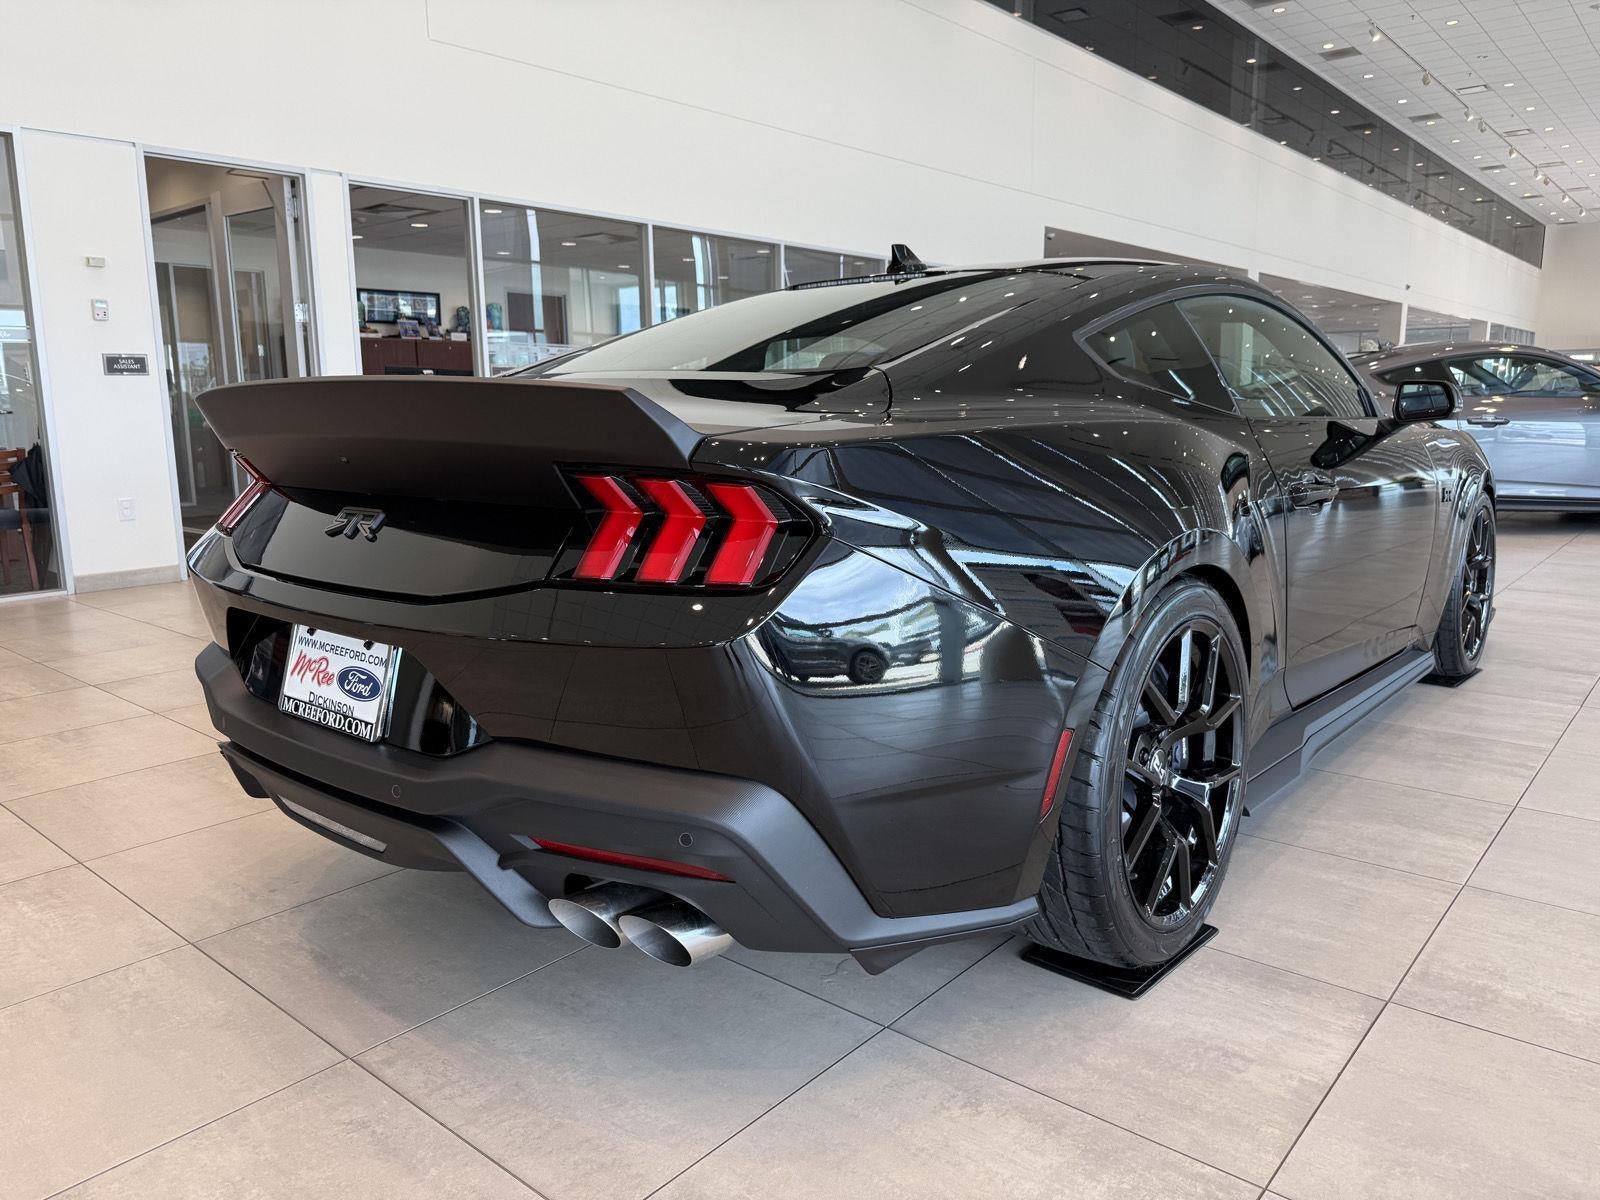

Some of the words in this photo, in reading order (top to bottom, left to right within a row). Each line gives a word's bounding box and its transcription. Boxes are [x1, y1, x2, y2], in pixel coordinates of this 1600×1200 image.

[290, 649, 335, 687] McRee
[298, 635, 386, 668] WWW.MCREEFORD.COM
[344, 670, 372, 697] Ford
[283, 697, 372, 740] MCREEFORD.COM
[308, 691, 355, 716] DICKINSON
